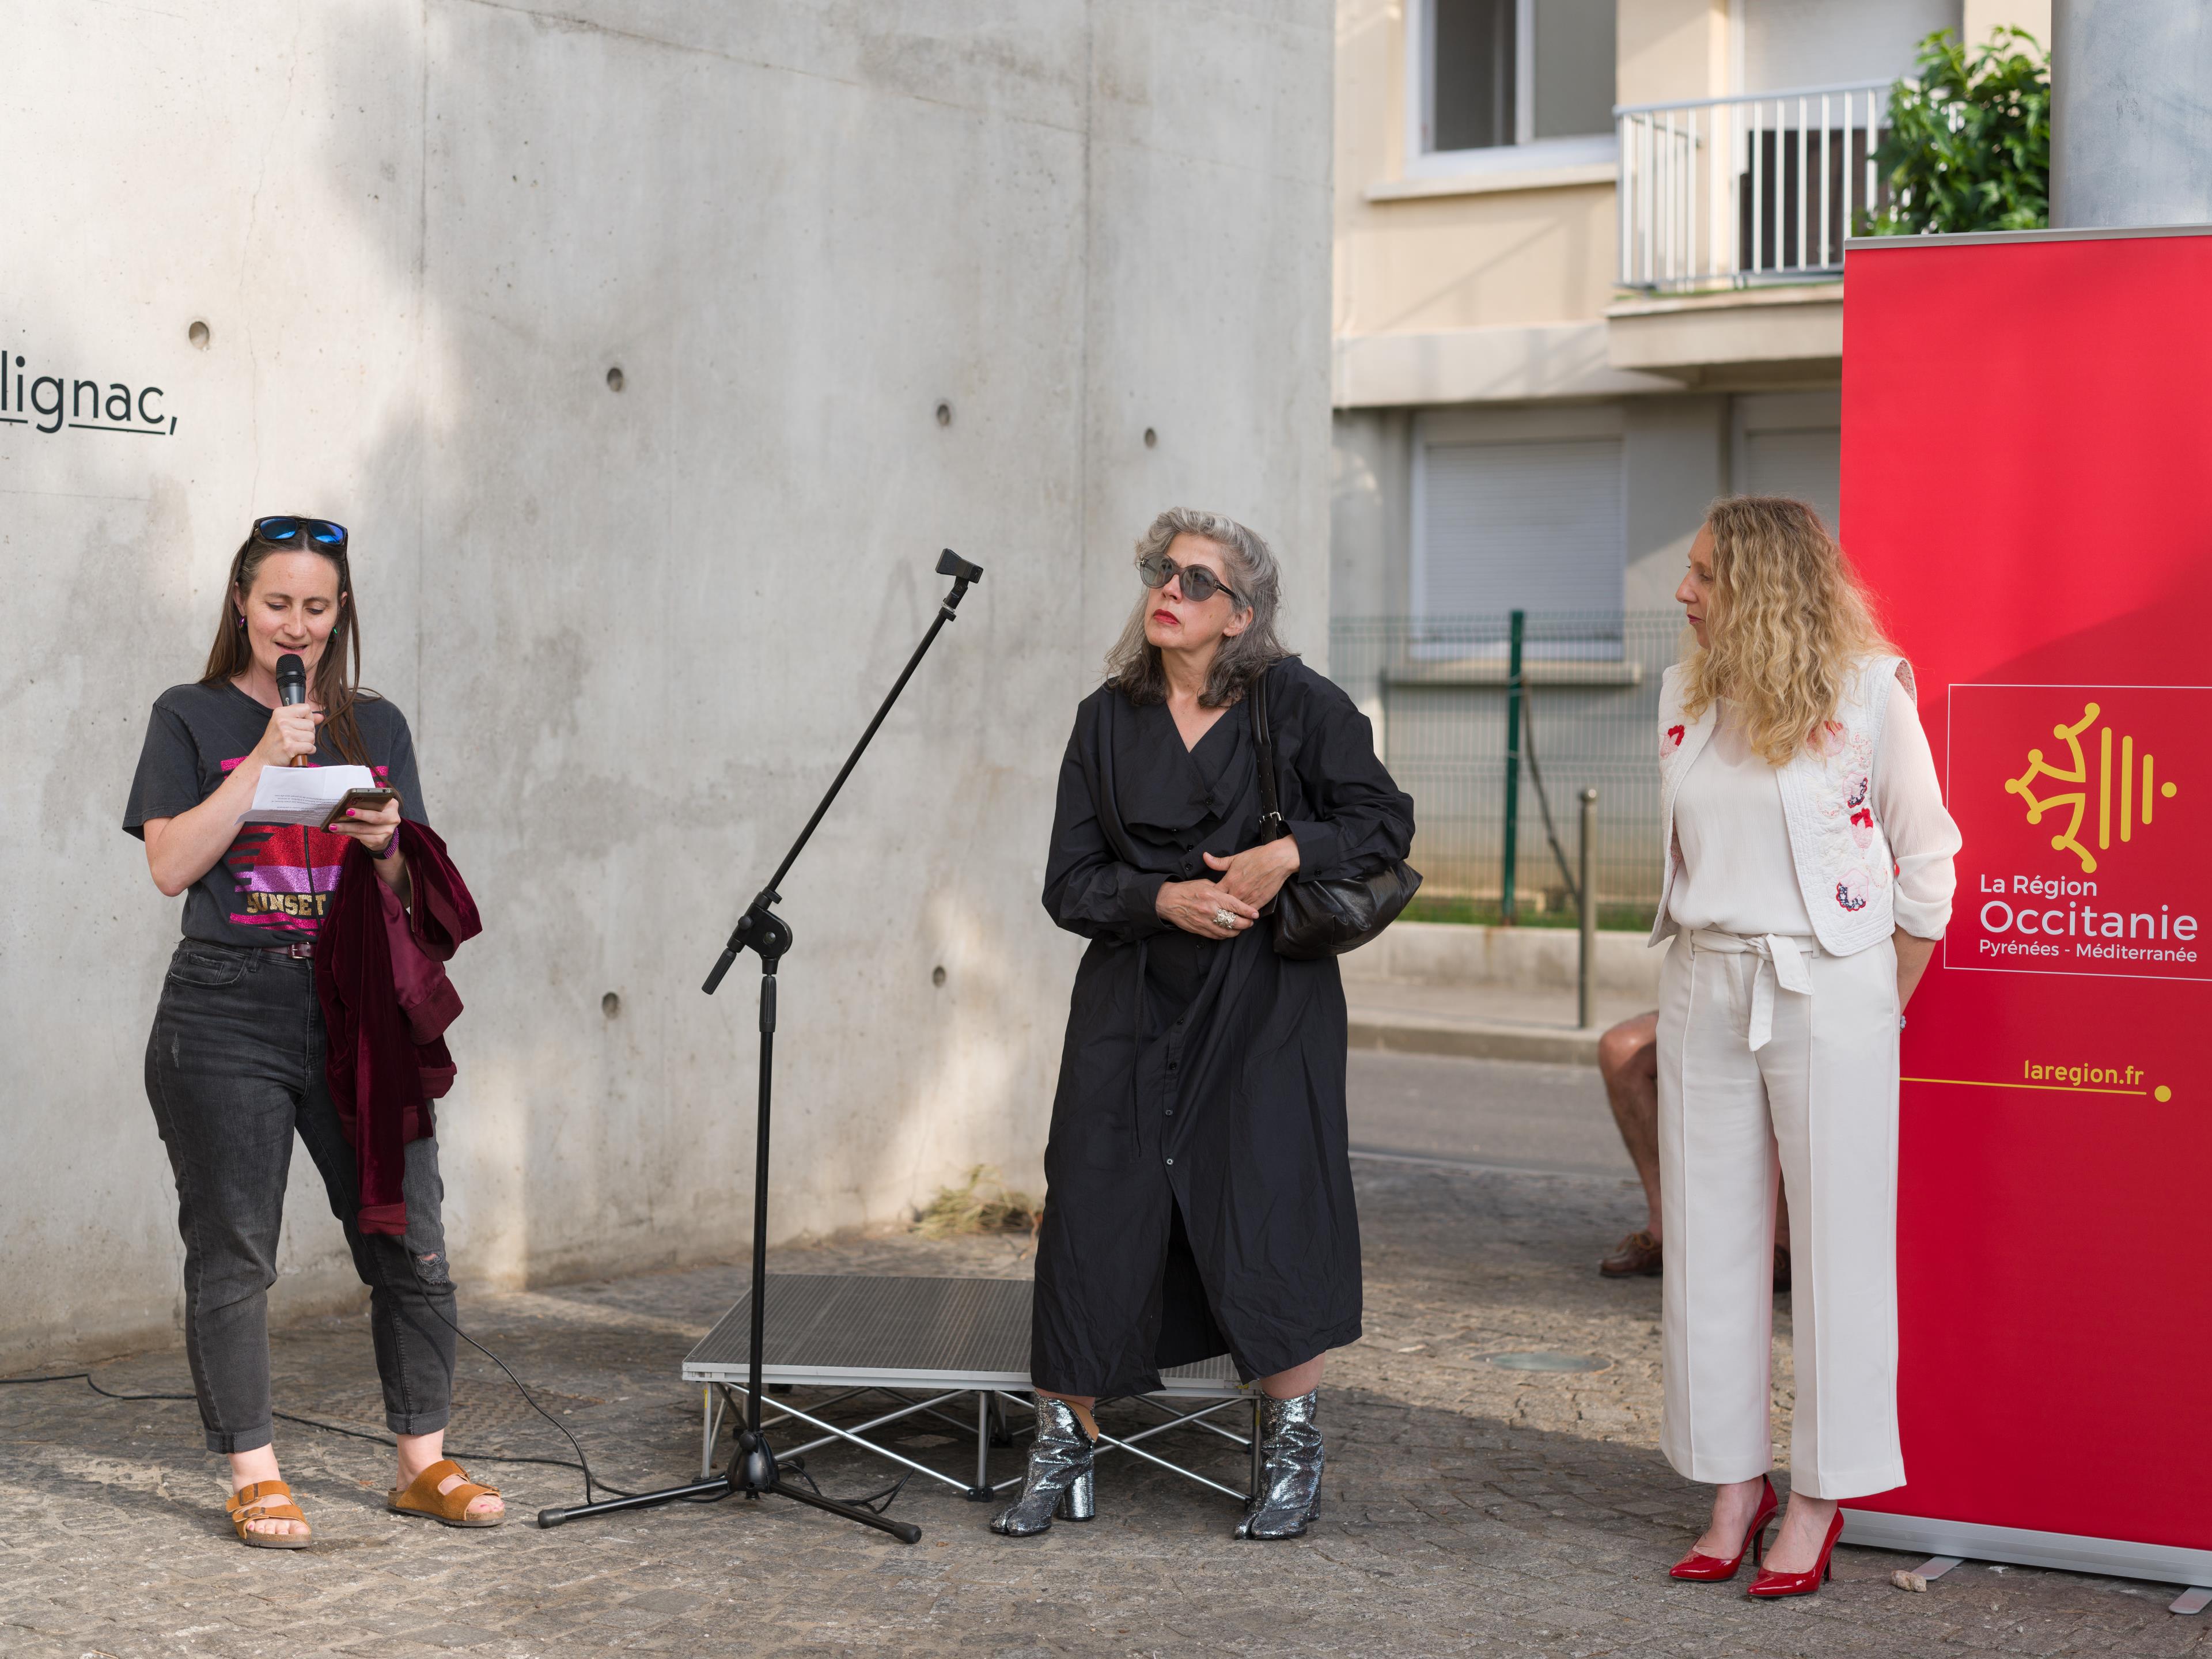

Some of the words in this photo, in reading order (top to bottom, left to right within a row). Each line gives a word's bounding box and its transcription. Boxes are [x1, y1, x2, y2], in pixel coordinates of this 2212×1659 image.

[1, 350, 177, 435] lignac,
[1980, 874, 2005, 893] La
[2013, 874, 2097, 900] Région
[247, 892, 326, 915] SUNSET
[1980, 900, 2198, 941] Occitanie
[1980, 939, 2059, 957] Pyrénées
[2076, 943, 2197, 963] Méditerranée
[2024, 1059, 2144, 1086] laregion.fr
